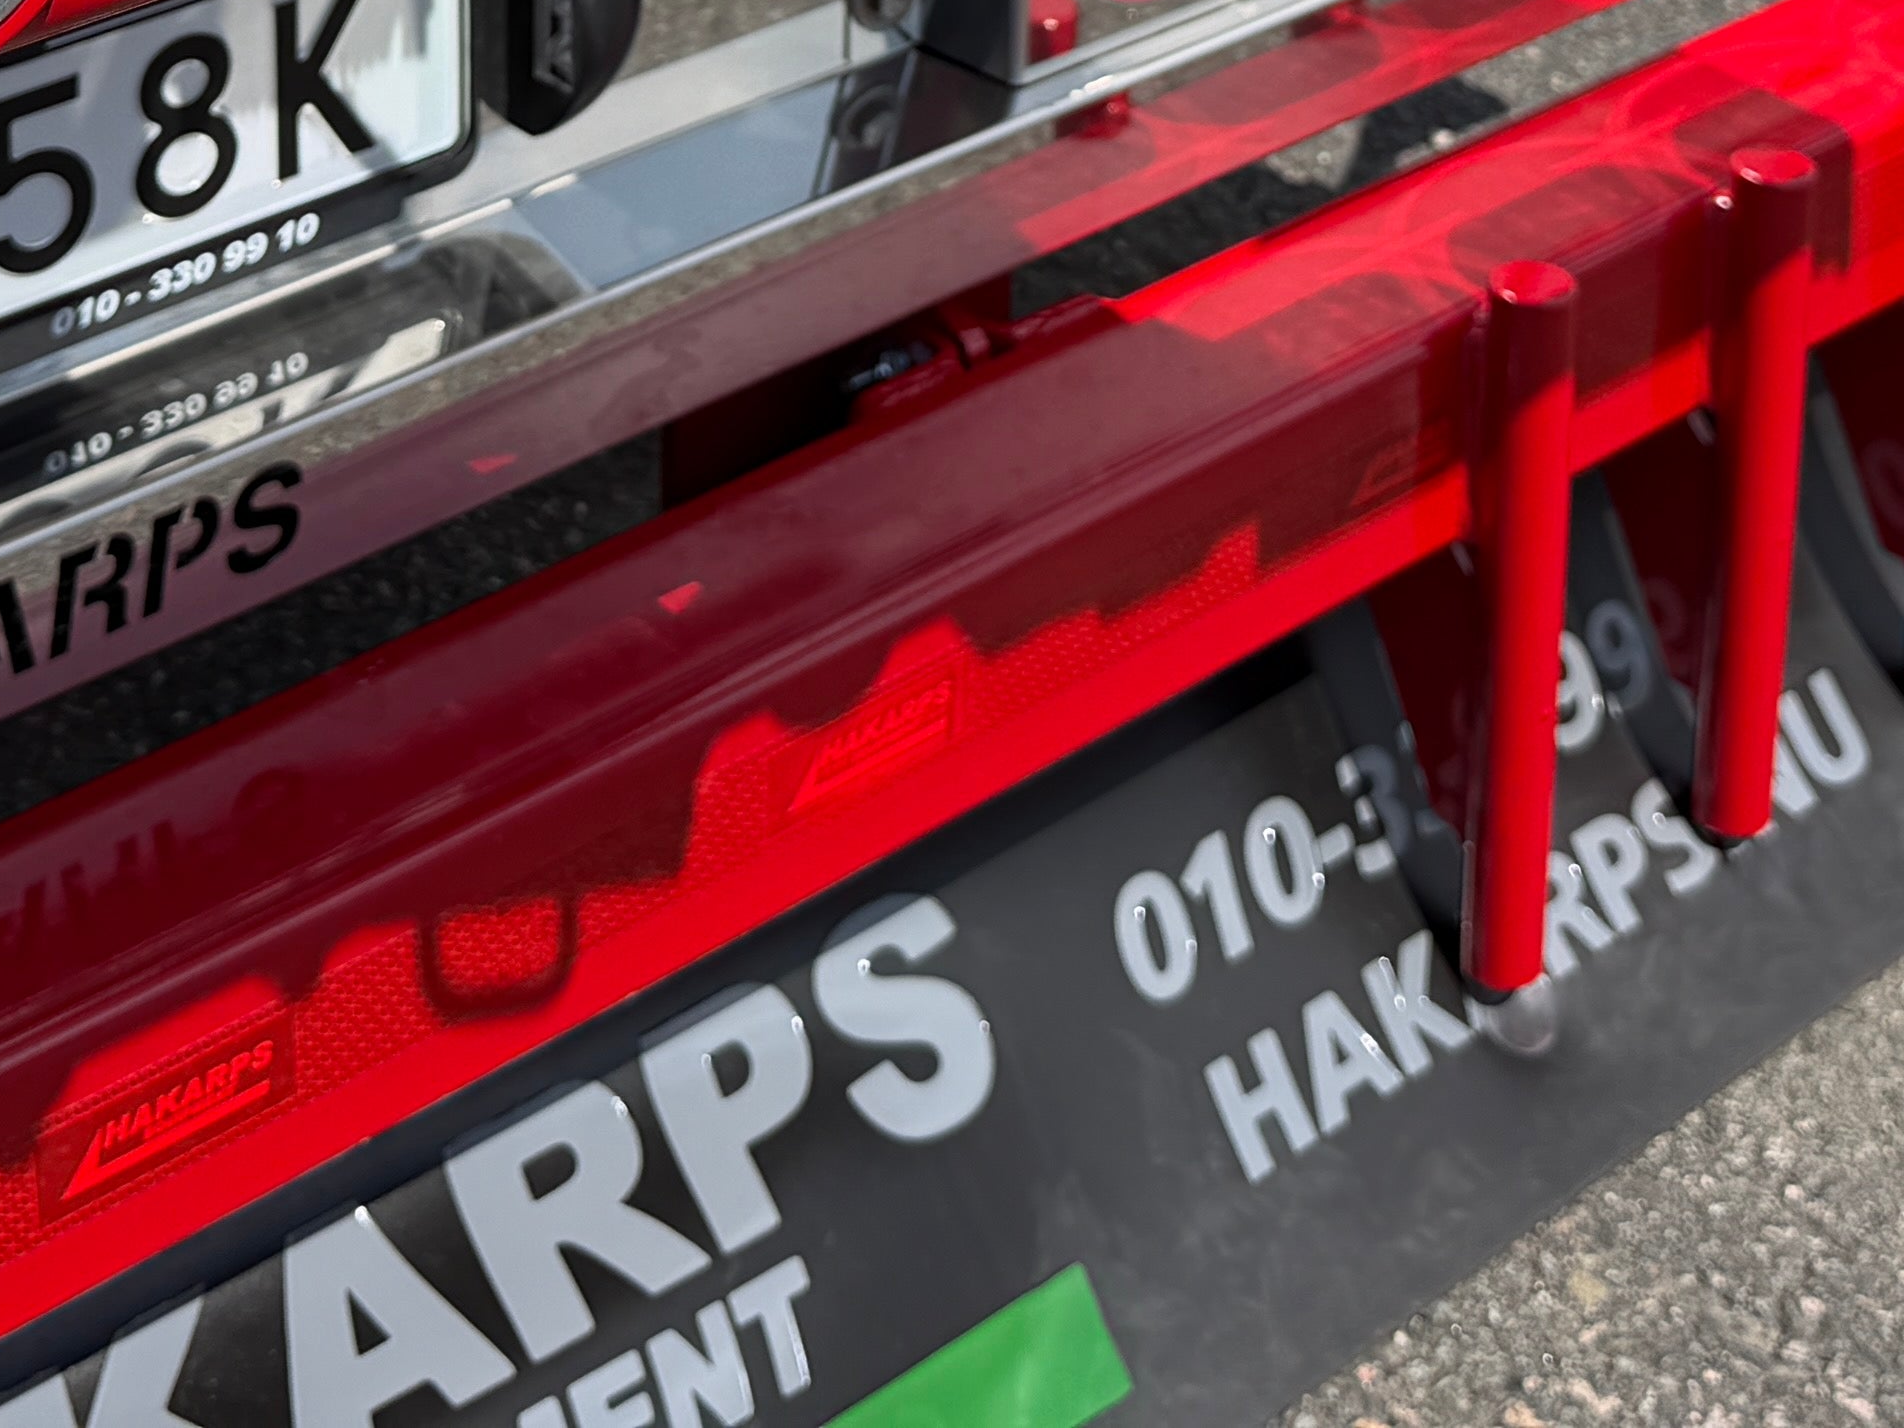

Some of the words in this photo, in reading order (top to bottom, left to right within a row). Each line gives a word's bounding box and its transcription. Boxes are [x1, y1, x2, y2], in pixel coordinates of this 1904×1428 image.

[51, 291, 119, 339] 010
[148, 251, 217, 303] 330
[222, 229, 270, 271] 99
[277, 213, 321, 252] 10
[103, 1040, 275, 1150] HAKARPS
[516, 1254, 811, 1428] ENT
